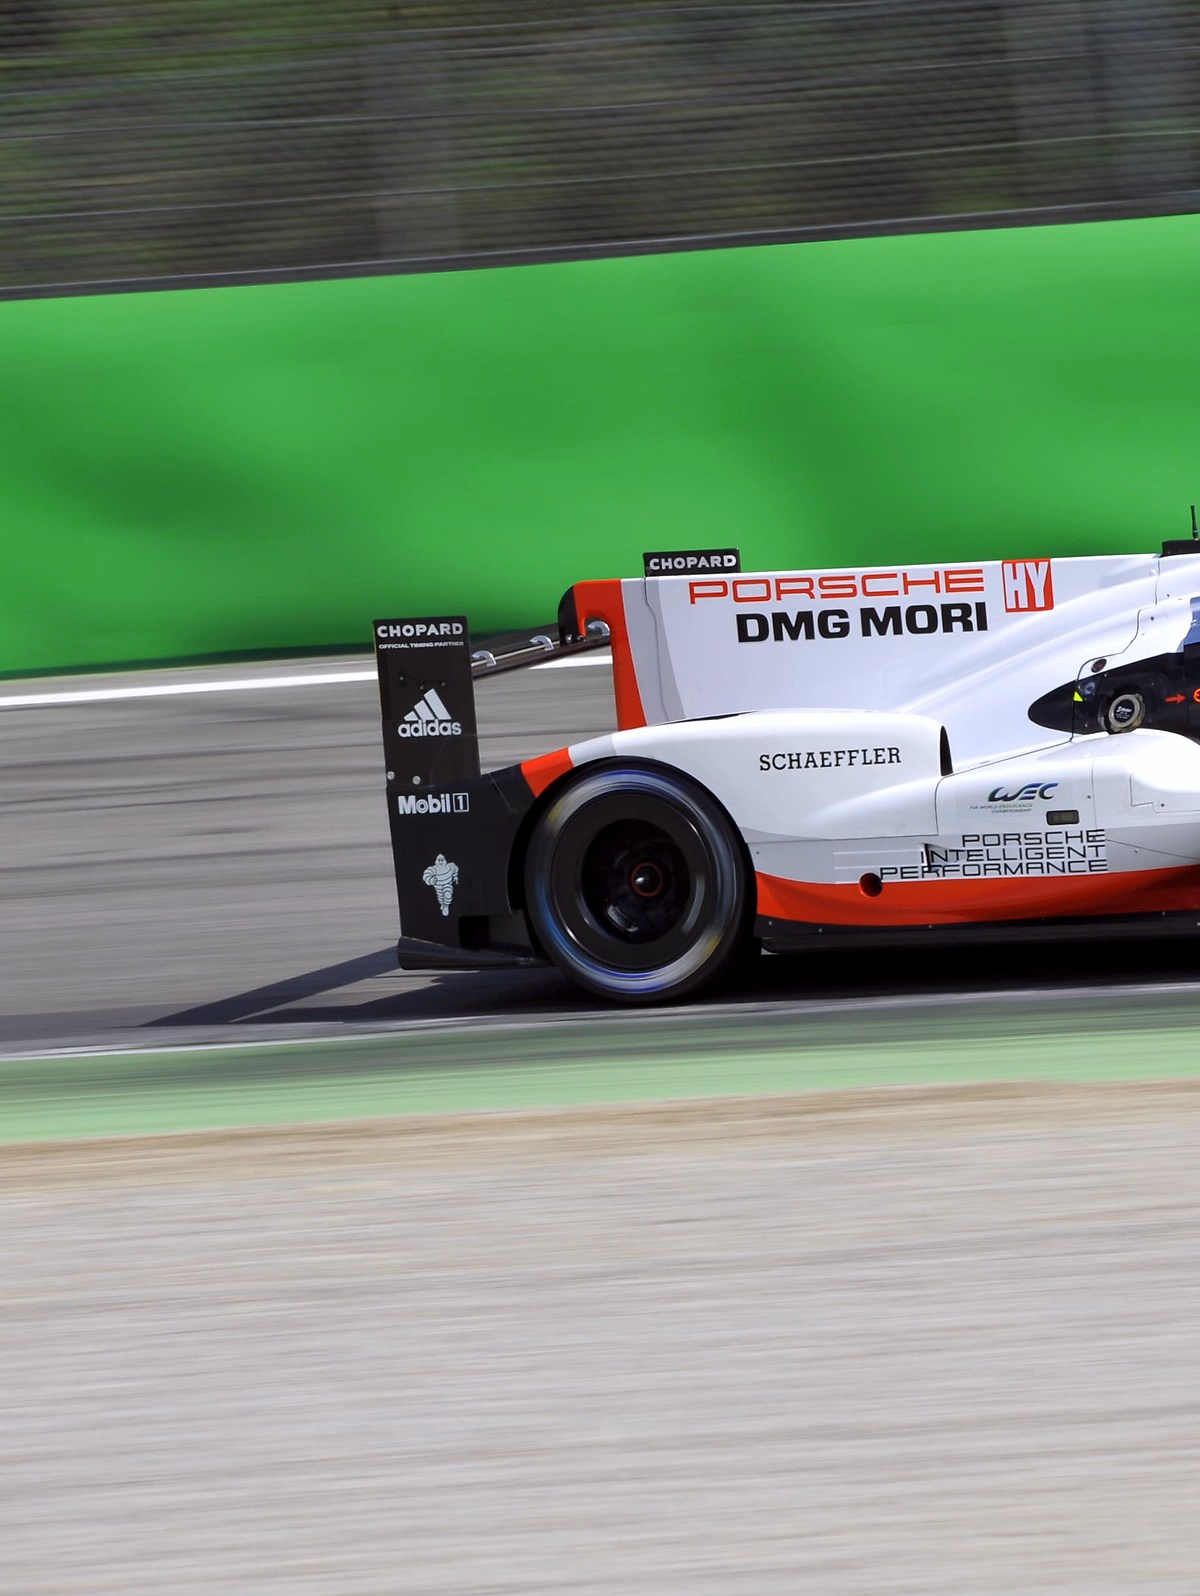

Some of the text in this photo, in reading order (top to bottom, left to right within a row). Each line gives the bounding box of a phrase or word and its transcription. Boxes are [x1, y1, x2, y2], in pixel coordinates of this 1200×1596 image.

[649, 554, 737, 570] CHOPARD
[688, 568, 985, 605] PORSCHE
[1002, 561, 1050, 610] HY
[376, 622, 464, 638] CHOPARD
[736, 601, 989, 643] DMG MORI
[398, 718, 462, 738] adidas
[759, 747, 902, 771] SCHAEFFLER
[988, 782, 1059, 802] WEC
[398, 793, 452, 814] Mobil
[961, 829, 1105, 847] PORSCHE
[920, 844, 1106, 864] INTELLIGENT
[879, 859, 1109, 880] PERFORMANCE
